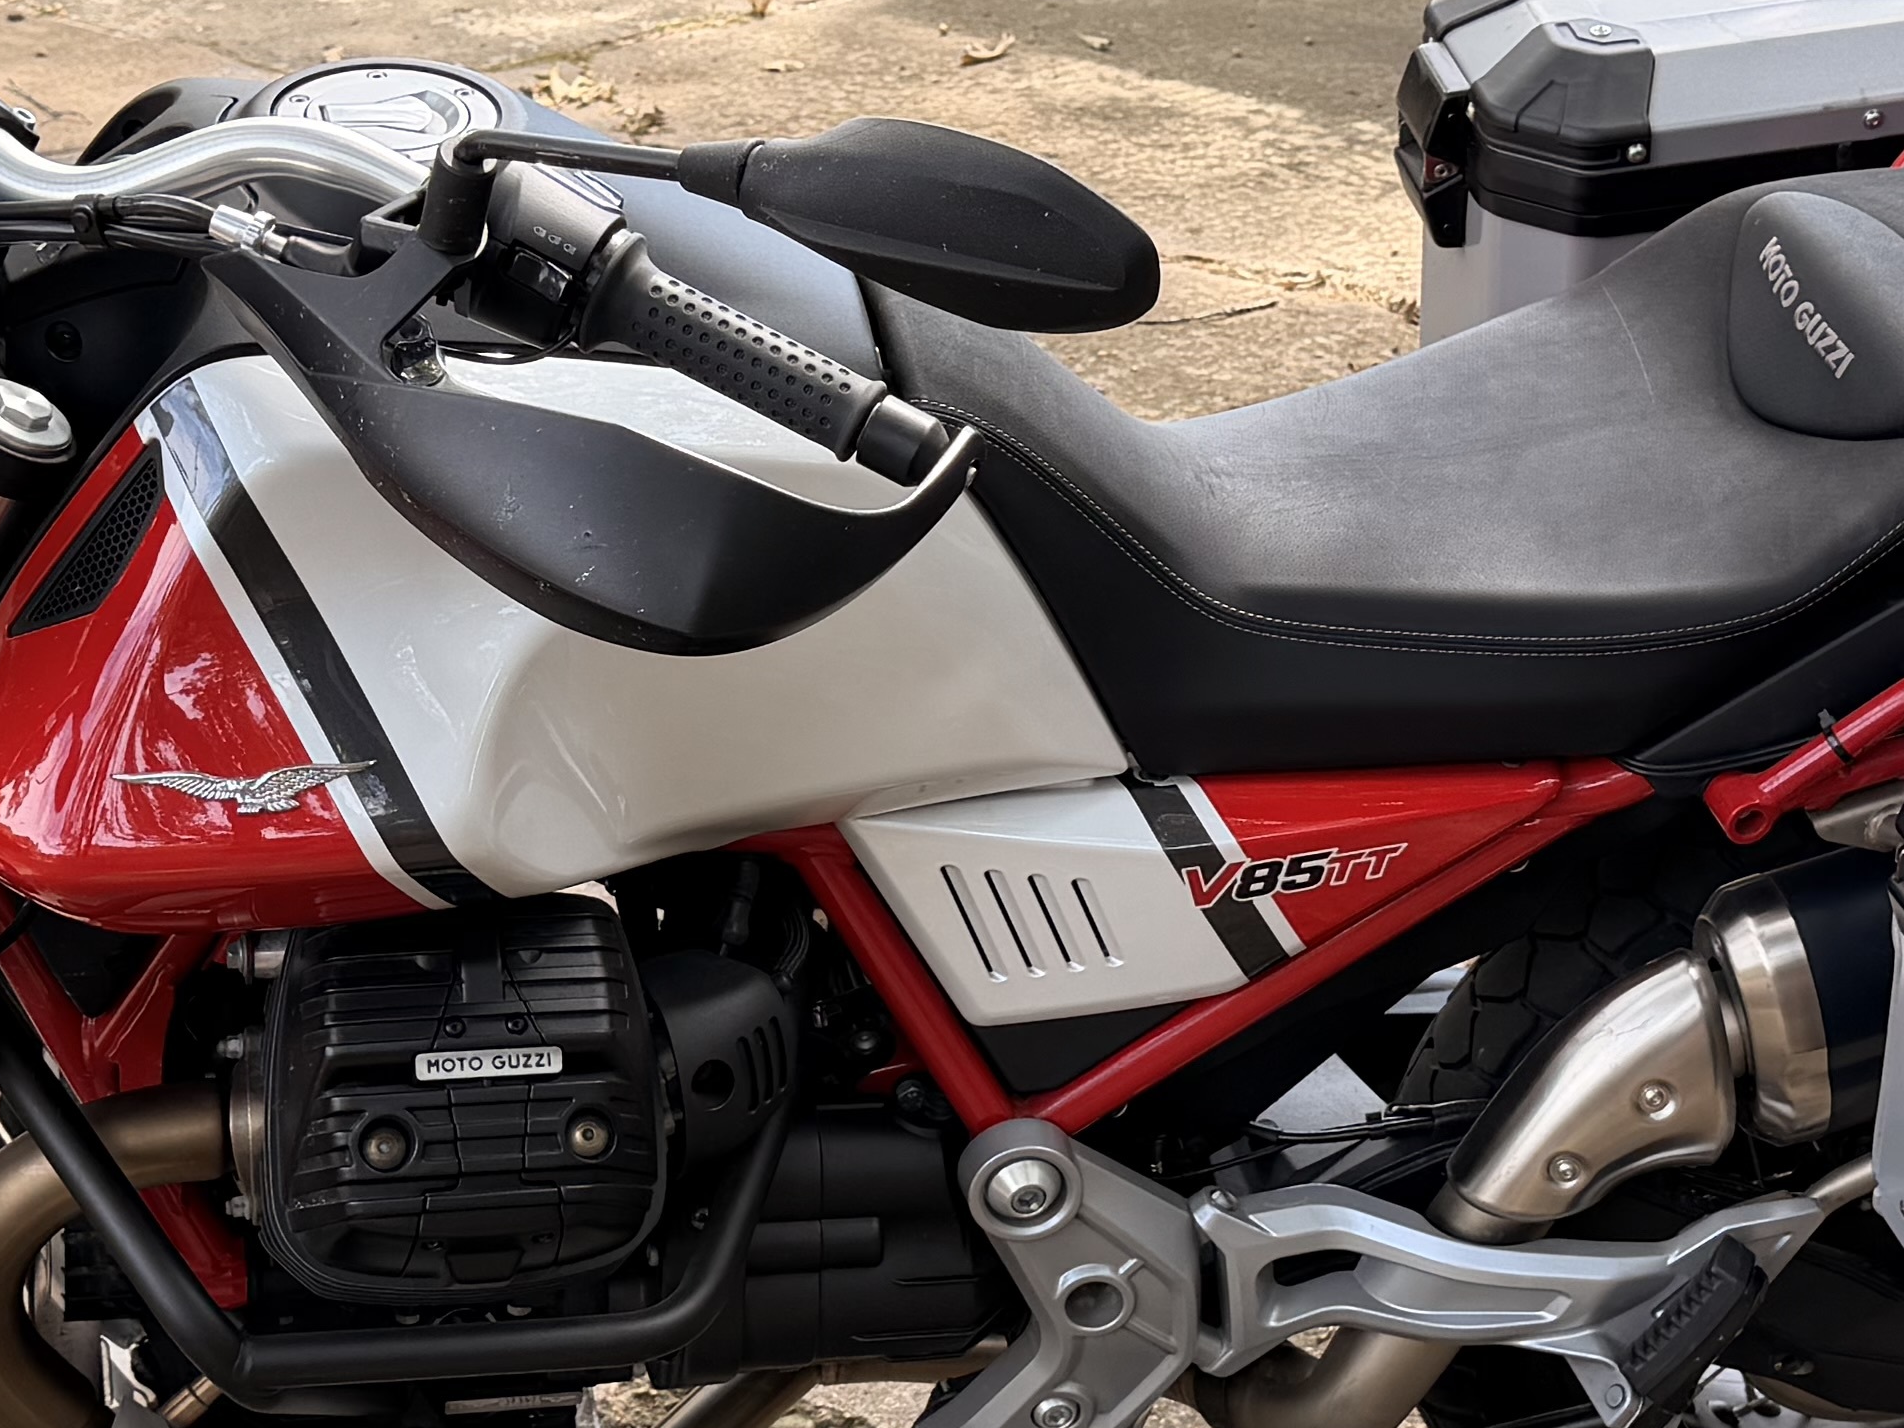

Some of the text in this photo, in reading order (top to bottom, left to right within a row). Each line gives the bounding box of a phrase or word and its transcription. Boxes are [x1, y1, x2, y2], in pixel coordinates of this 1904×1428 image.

[1759, 236, 1856, 379] MOTO GUZZI
[1181, 842, 1408, 909] V85TT
[427, 1052, 552, 1074] MOTO GUZZI
